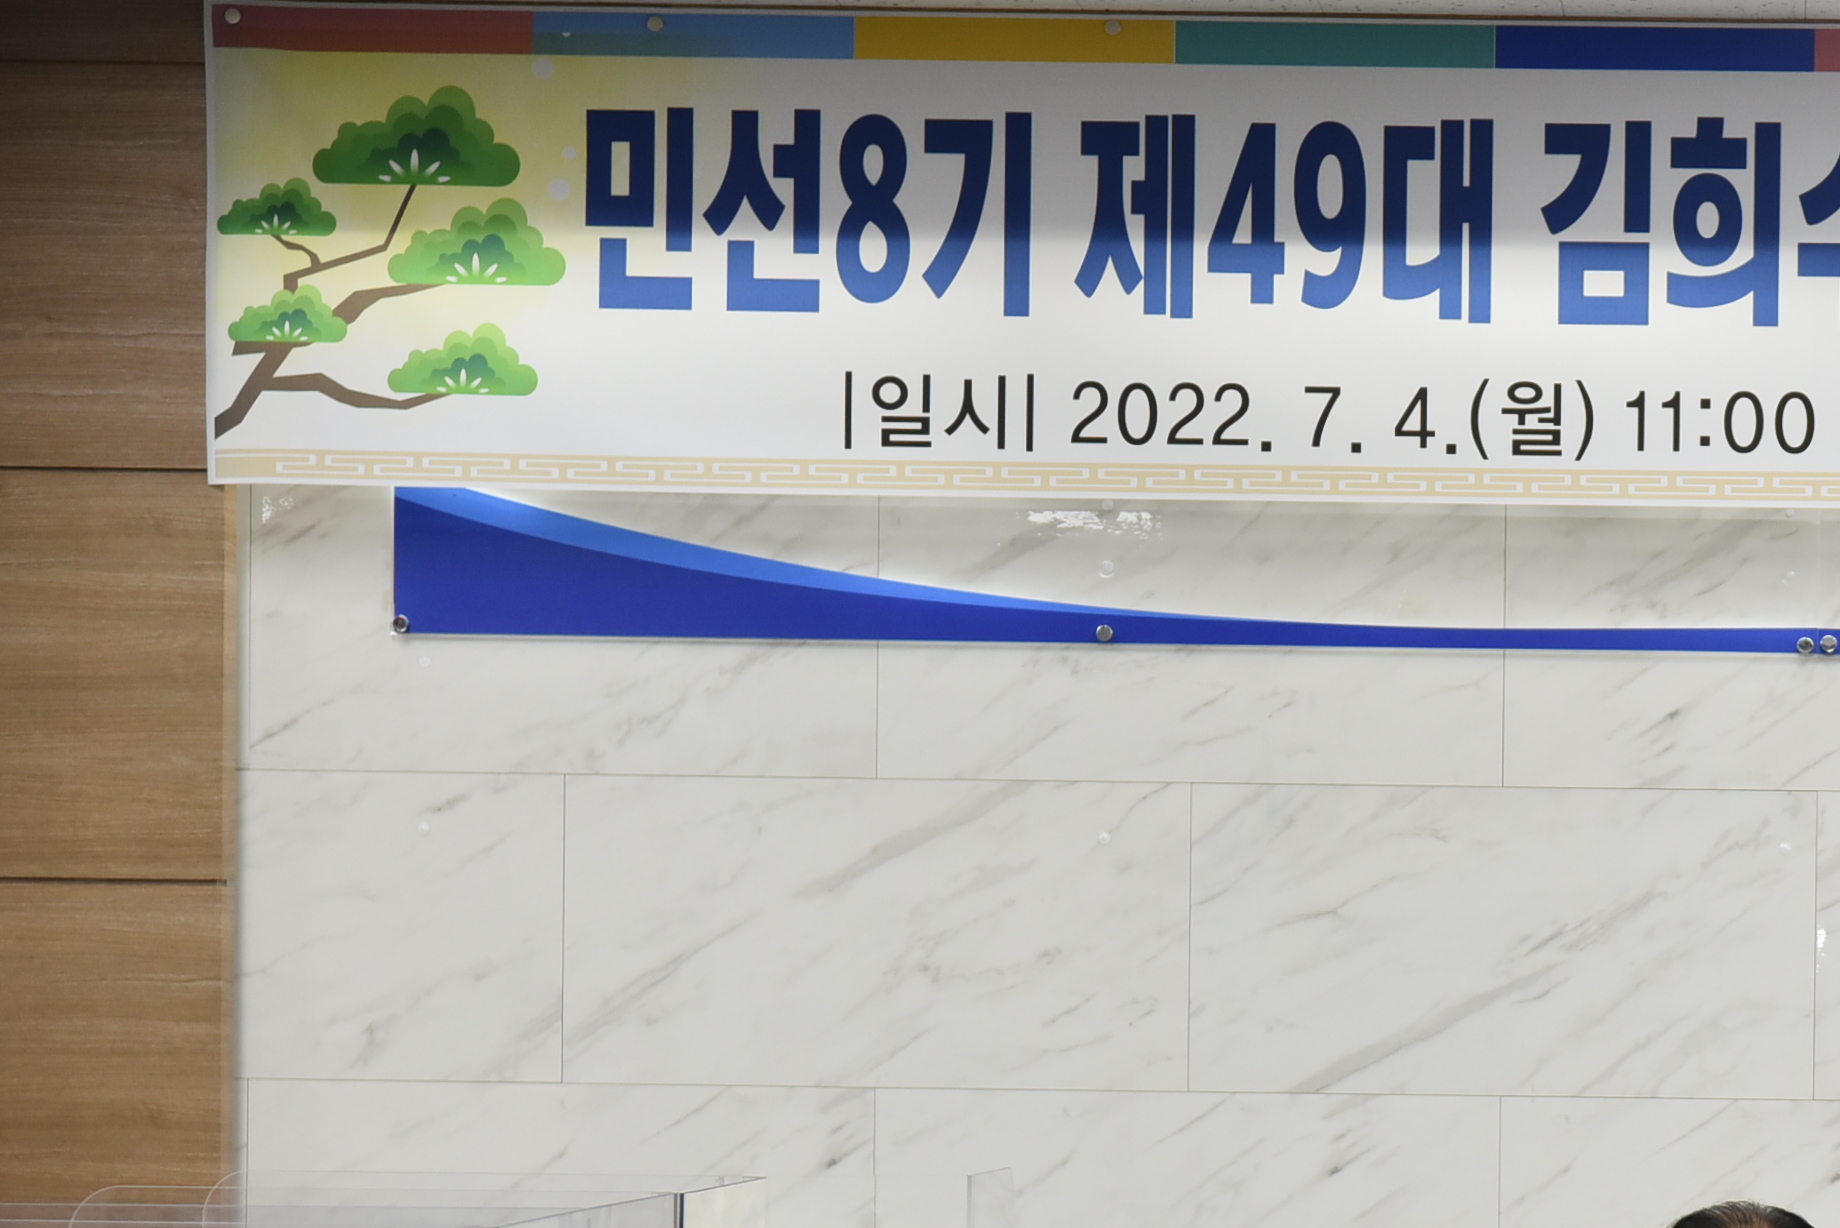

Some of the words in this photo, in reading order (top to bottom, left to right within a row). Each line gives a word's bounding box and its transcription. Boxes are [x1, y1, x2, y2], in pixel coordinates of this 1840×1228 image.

[585, 107, 1032, 317] 민선8기
[1075, 114, 1494, 323] 제49대
[1071, 381, 1271, 453] 2022.
[1305, 386, 1361, 453] 7.
[1395, 379, 1593, 461] 4.(월)
[1626, 391, 1815, 455] 11:00
